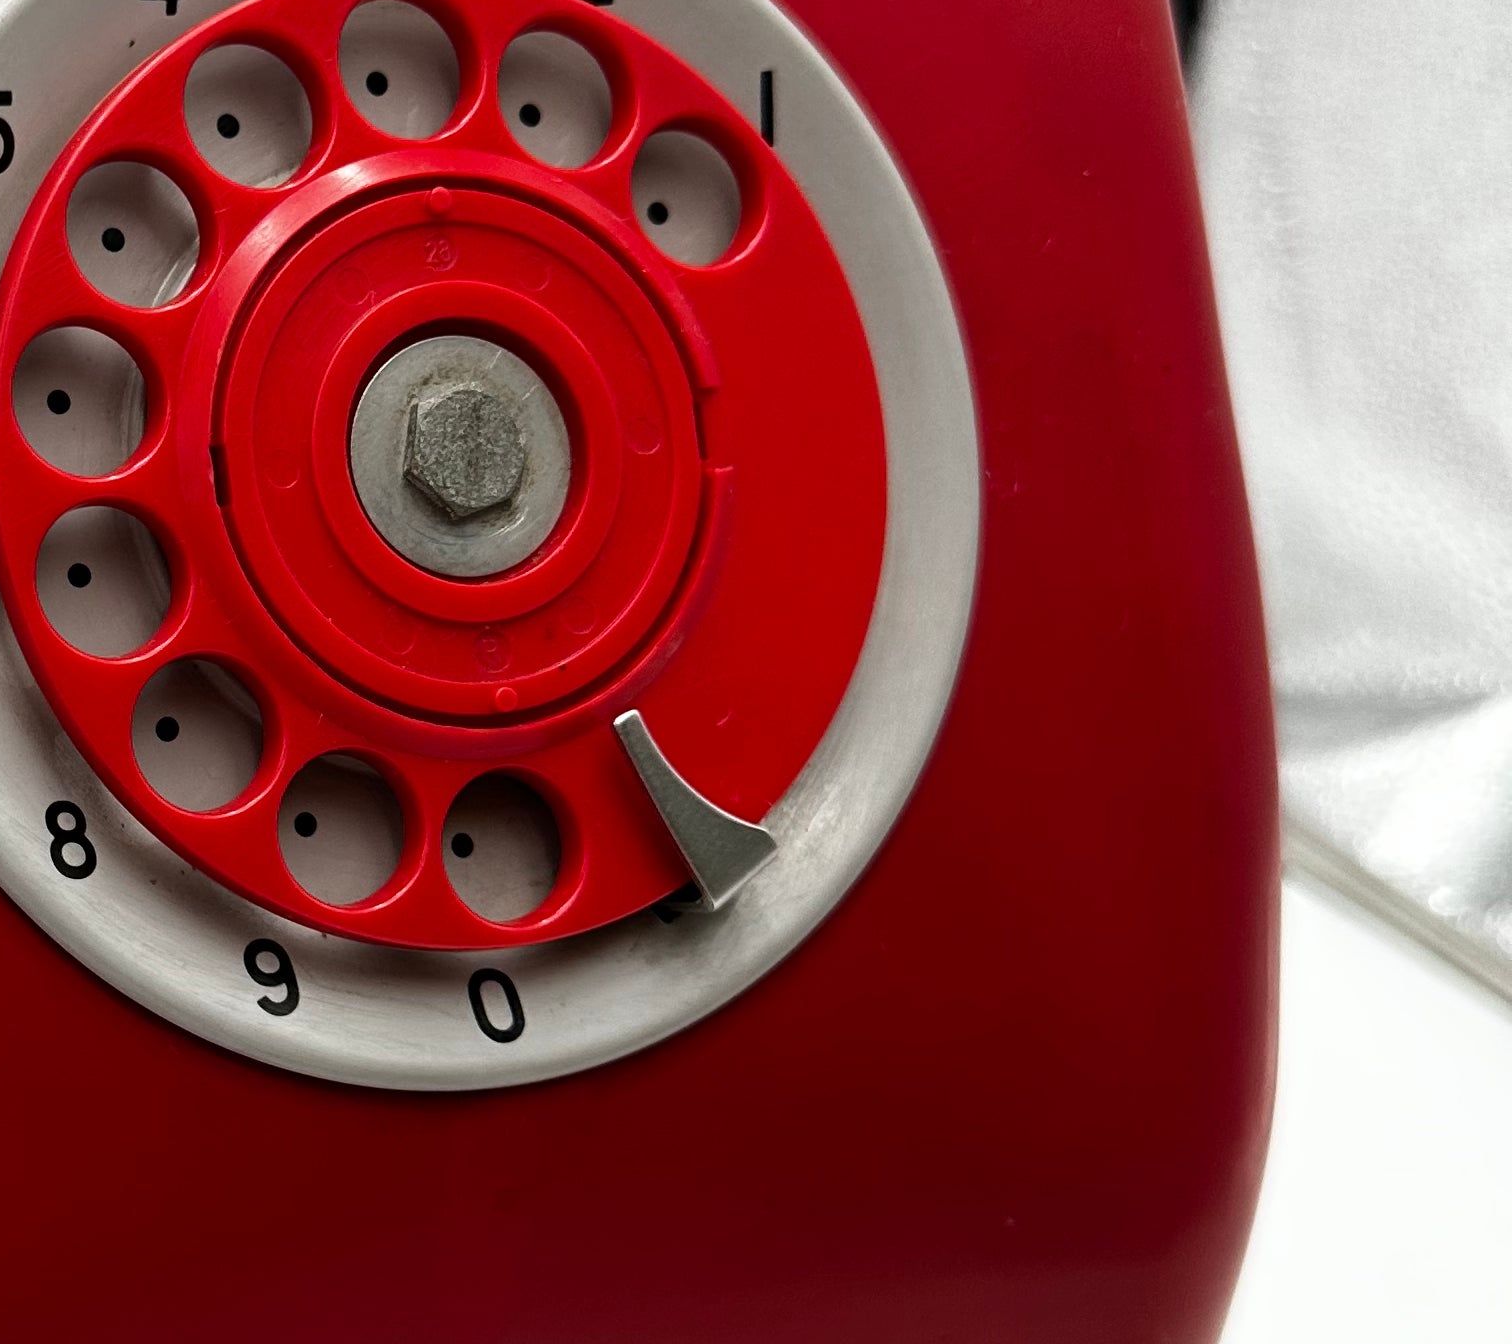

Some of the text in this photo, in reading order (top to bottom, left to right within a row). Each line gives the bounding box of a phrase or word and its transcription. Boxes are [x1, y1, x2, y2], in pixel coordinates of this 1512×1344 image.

[760, 70, 775, 147] 1
[45, 800, 97, 879] 8
[243, 938, 300, 1016] 9
[468, 968, 526, 1043] 0
